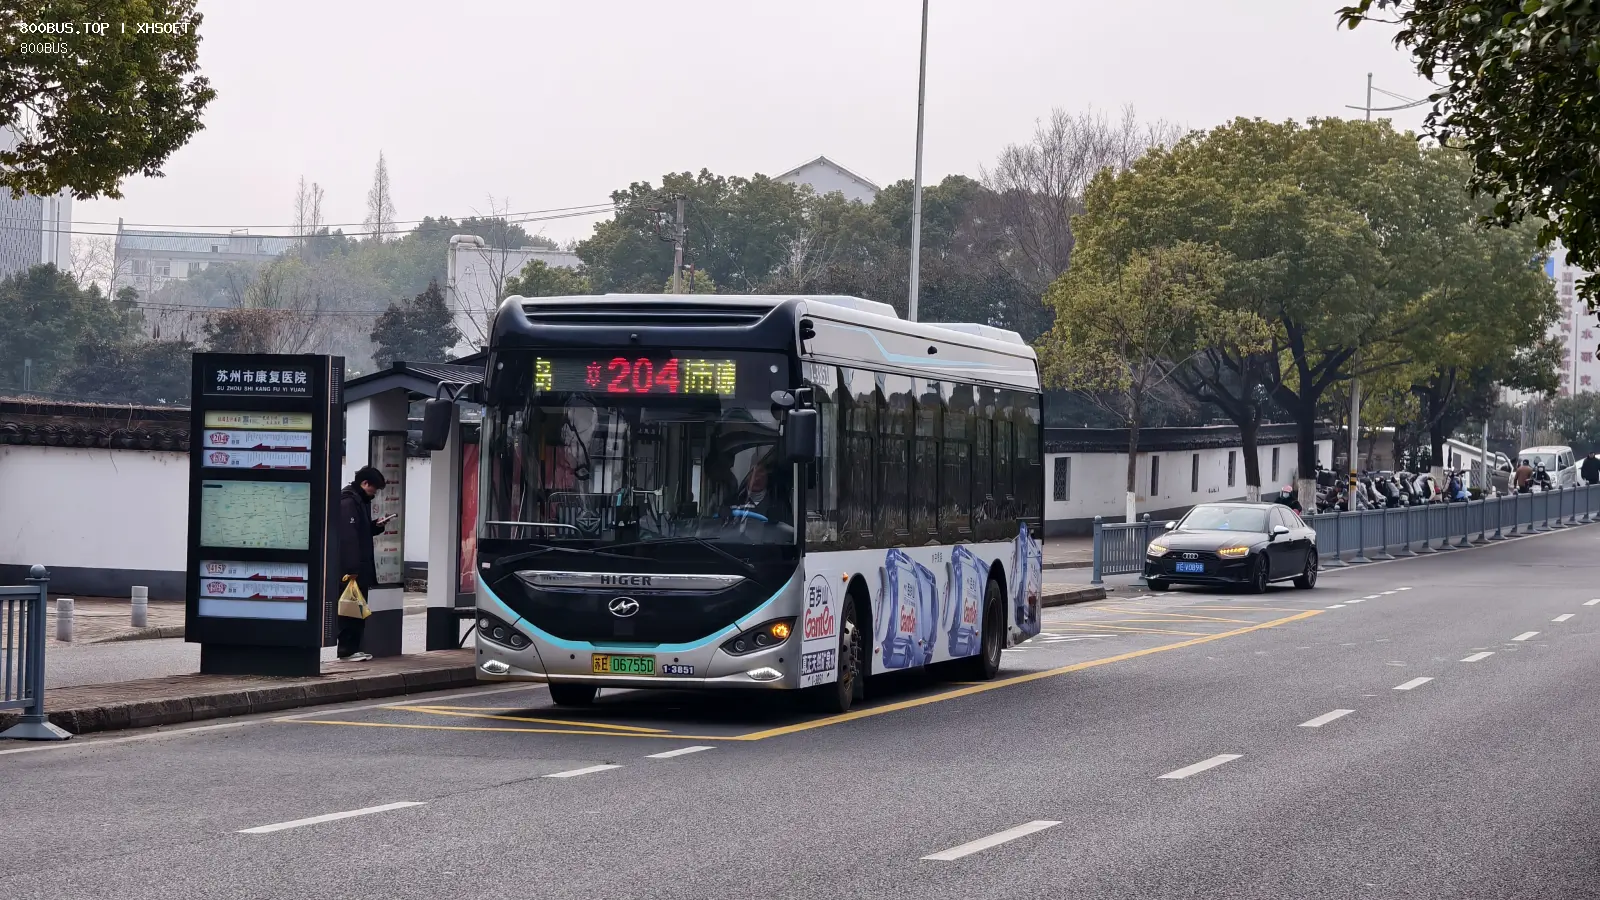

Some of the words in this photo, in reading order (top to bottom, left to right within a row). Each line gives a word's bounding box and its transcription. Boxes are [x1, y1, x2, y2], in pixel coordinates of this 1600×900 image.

[216, 369, 307, 384] 苏州市康复医院
[607, 357, 680, 393] 204
[210, 563, 222, 572] 415
[600, 575, 651, 586] HIGER
